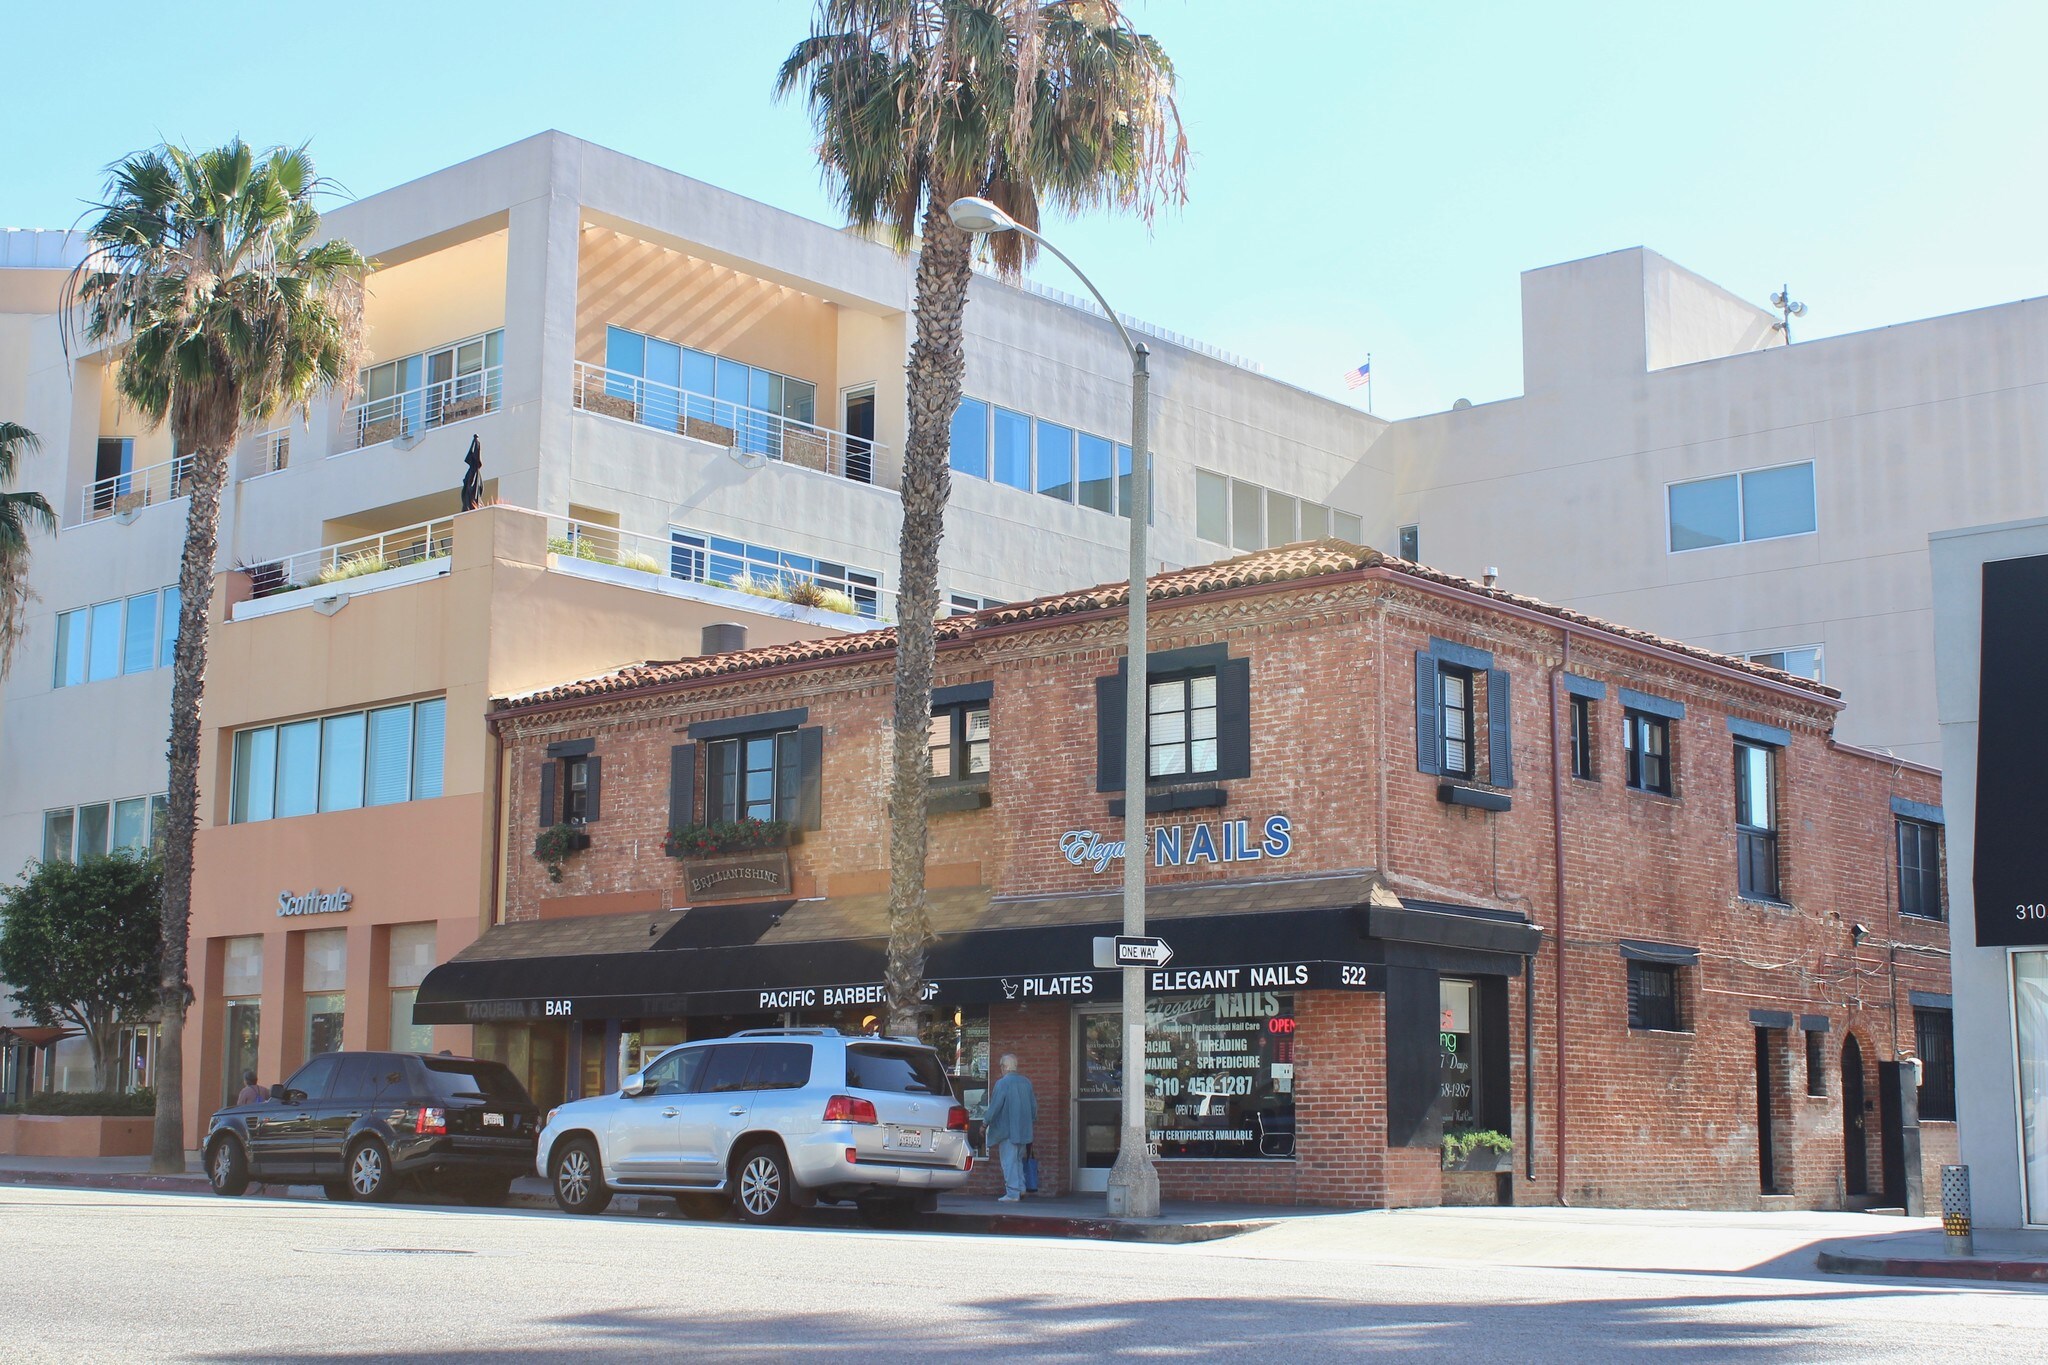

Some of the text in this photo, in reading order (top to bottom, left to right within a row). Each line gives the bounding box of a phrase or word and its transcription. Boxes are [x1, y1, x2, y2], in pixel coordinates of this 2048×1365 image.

[1059, 815, 1292, 874] Elega NAILS
[276, 886, 353, 917] Scottrade
[1121, 946, 1157, 959] ONE WAY
[1023, 975, 1094, 996] PILATES
[1152, 965, 1308, 991] ELEGANT NAILS
[1341, 966, 1367, 986] 522
[759, 989, 816, 1009] PACIFIC
[1215, 992, 1280, 1018] NAILS
[464, 1000, 526, 1018] TAQUERIA
[545, 1000, 572, 1016] BAR
[1192, 1023, 1231, 1032] Professional
[1231, 1022, 1244, 1031] Nail
[1245, 1022, 1260, 1031] Care
[1268, 1018, 1296, 1034] OPEN
[1197, 1038, 1248, 1052] THREADING
[1197, 1056, 1215, 1069] SPA
[1216, 1056, 1260, 1069] PEDICURE
[1449, 1053, 1469, 1073] Days
[1175, 1104, 1189, 1116] OPEN
[1211, 1104, 1225, 1116] WEEK
[1149, 1130, 1253, 1141] GIFT CERTIFICATES AVAILABLE
